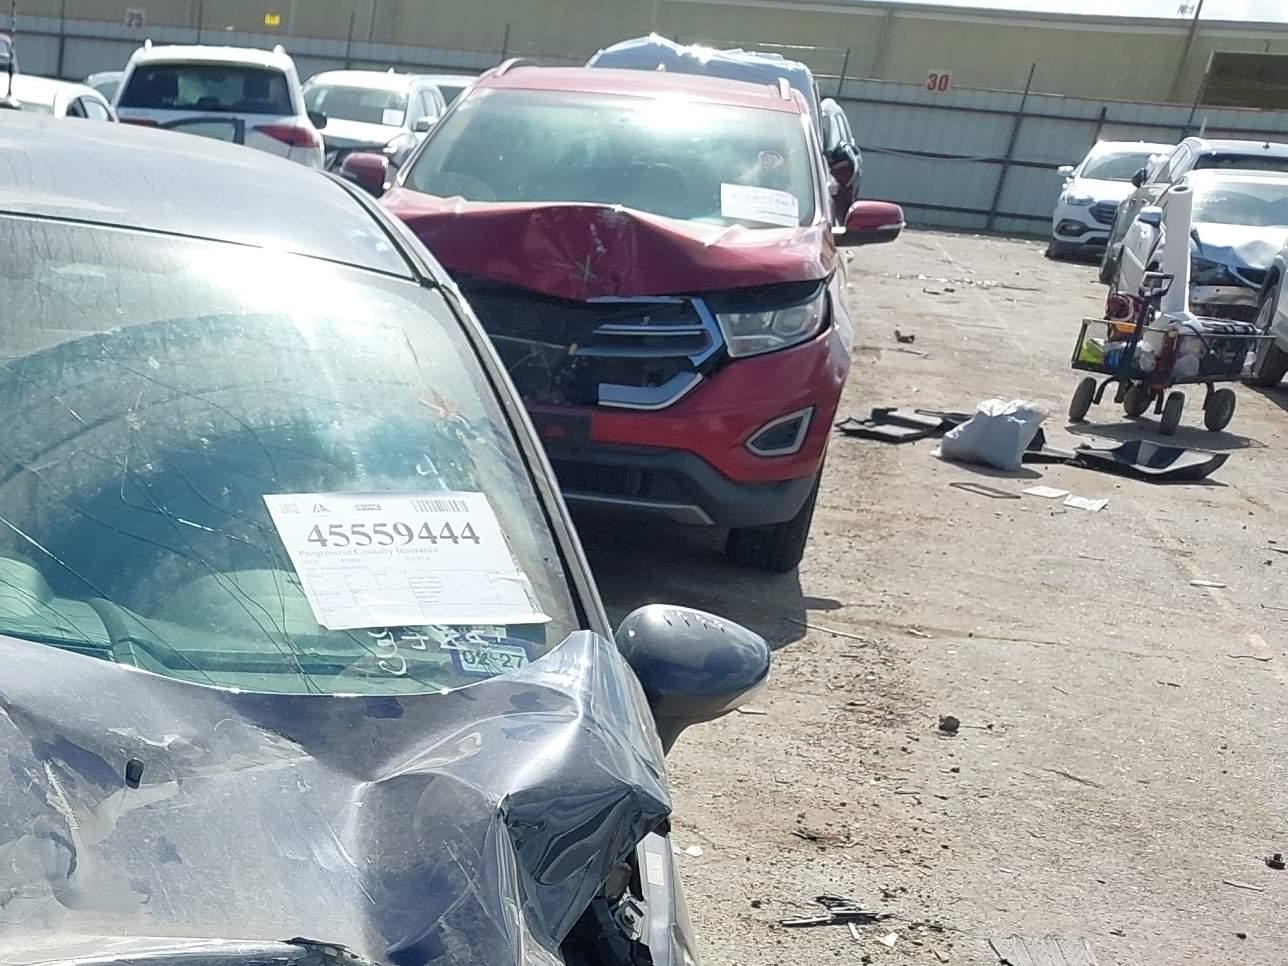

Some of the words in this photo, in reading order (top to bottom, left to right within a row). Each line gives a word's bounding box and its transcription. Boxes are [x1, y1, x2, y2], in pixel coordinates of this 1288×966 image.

[927, 73, 950, 91] 30
[306, 521, 481, 547] 45559444
[499, 653, 524, 669] 27
